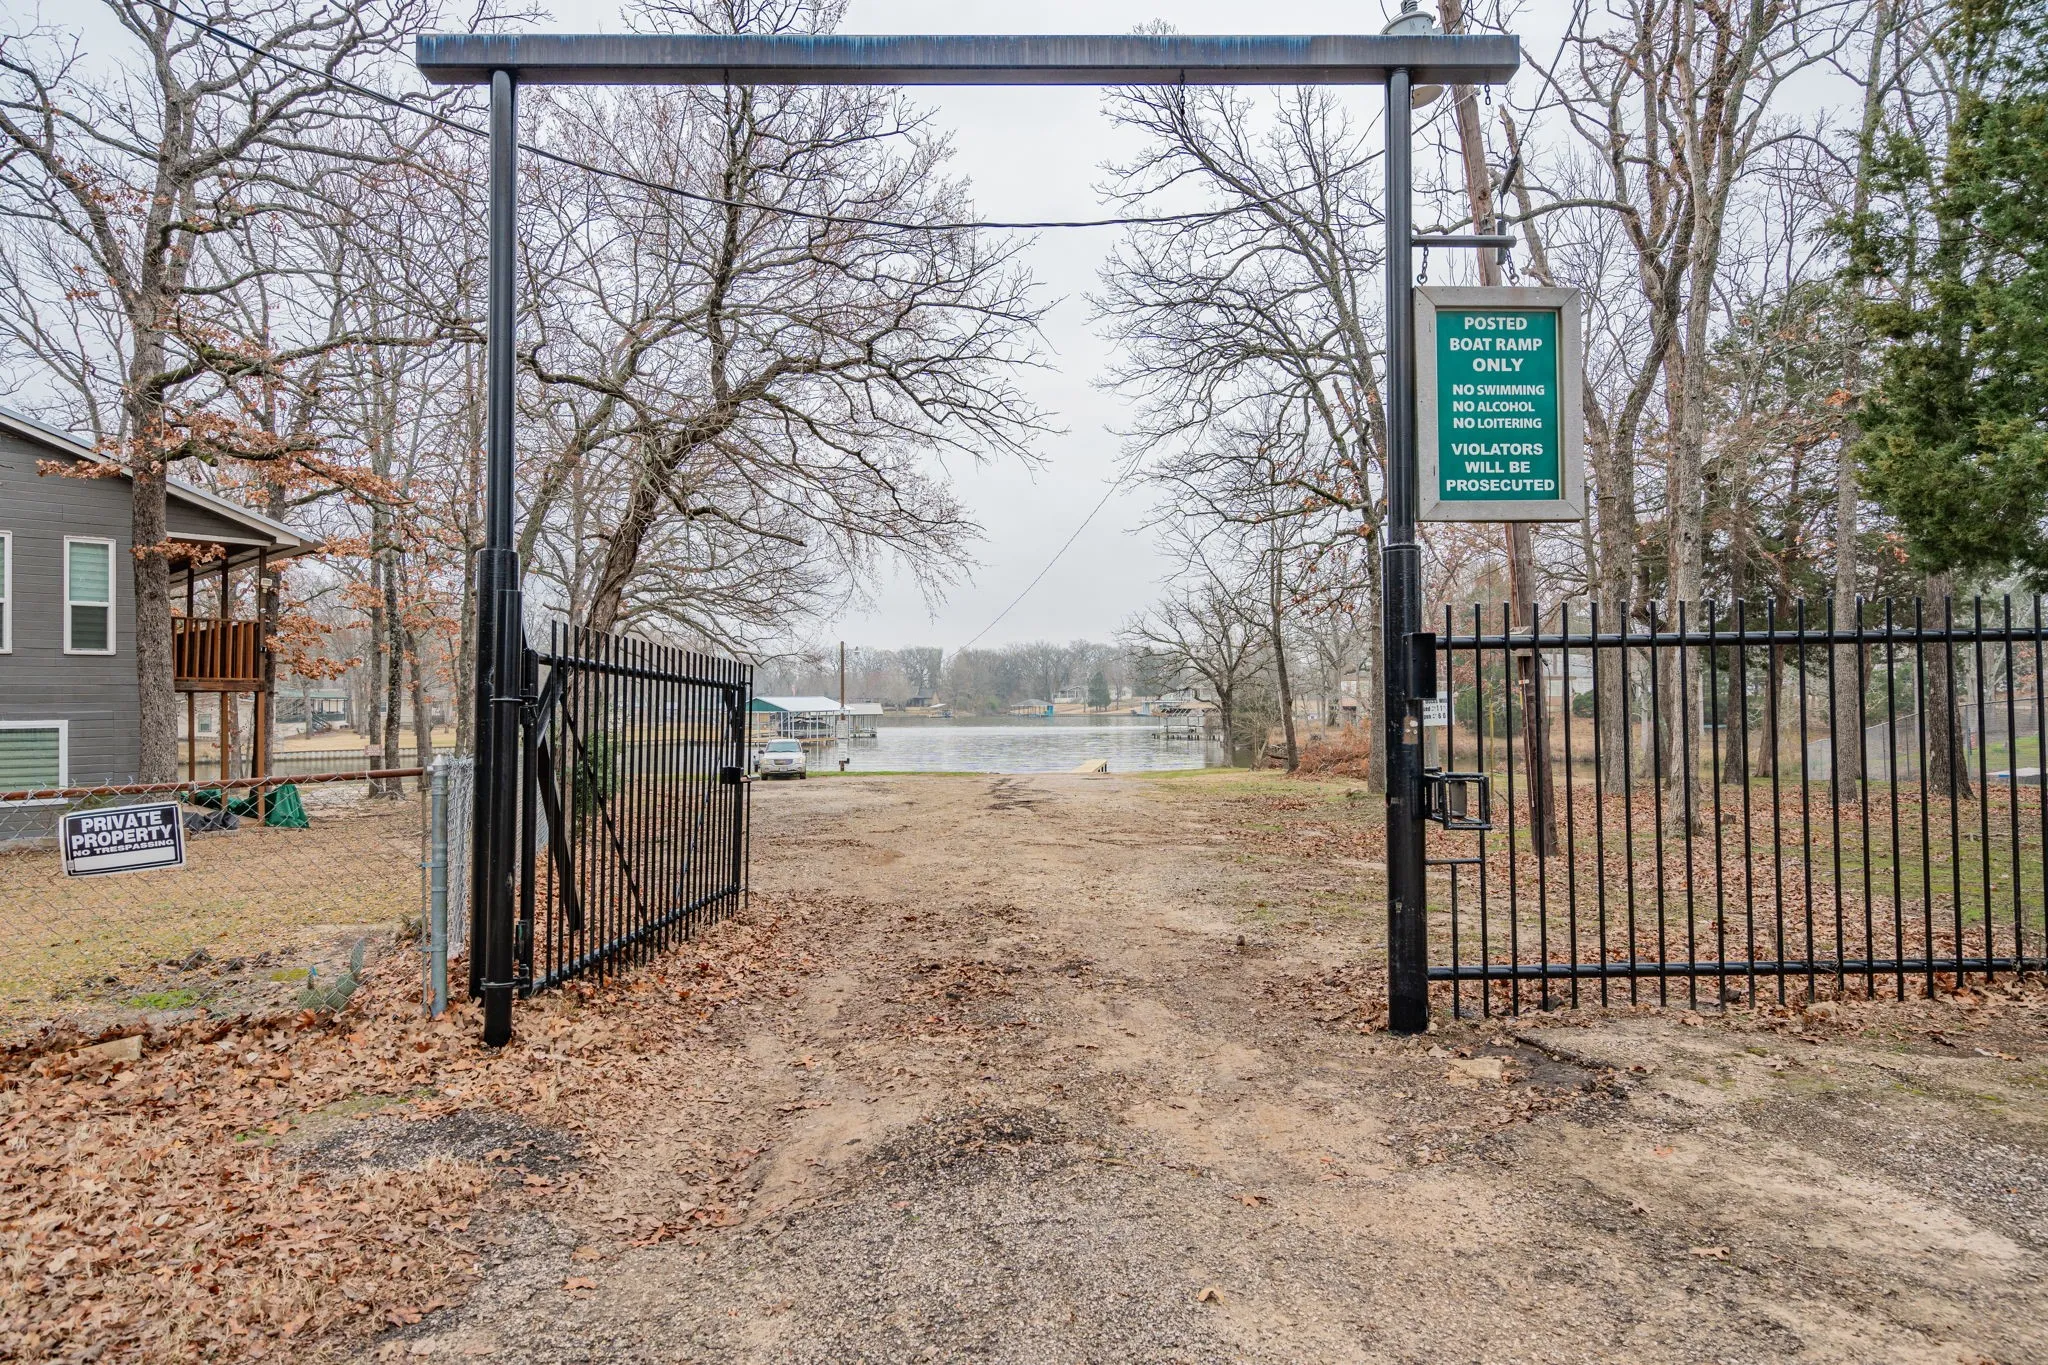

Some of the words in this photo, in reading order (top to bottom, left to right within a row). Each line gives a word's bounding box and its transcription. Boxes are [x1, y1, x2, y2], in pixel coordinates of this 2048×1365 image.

[1464, 316, 1528, 331] POSTED
[1449, 337, 1493, 351] BOAT
[1495, 337, 1543, 351] RAMP
[1472, 357, 1524, 372] ONLY
[1452, 384, 1475, 396] NO
[1476, 384, 1545, 396] SWIMMING
[1452, 400, 1475, 413] NO
[1477, 401, 1536, 413] ALCOHOL
[1453, 417, 1476, 430] NO
[1477, 418, 1542, 429] LOITERING
[1451, 443, 1544, 456] VIOLATORS
[1464, 461, 1505, 474] WILL
[1509, 461, 1531, 474] BE
[1446, 479, 1555, 492] PROSECUTED
[81, 811, 162, 833] PRIVATE
[71, 824, 173, 850] PROPERTY
[73, 849, 90, 857] NO
[93, 839, 174, 855] TRESPASSING
